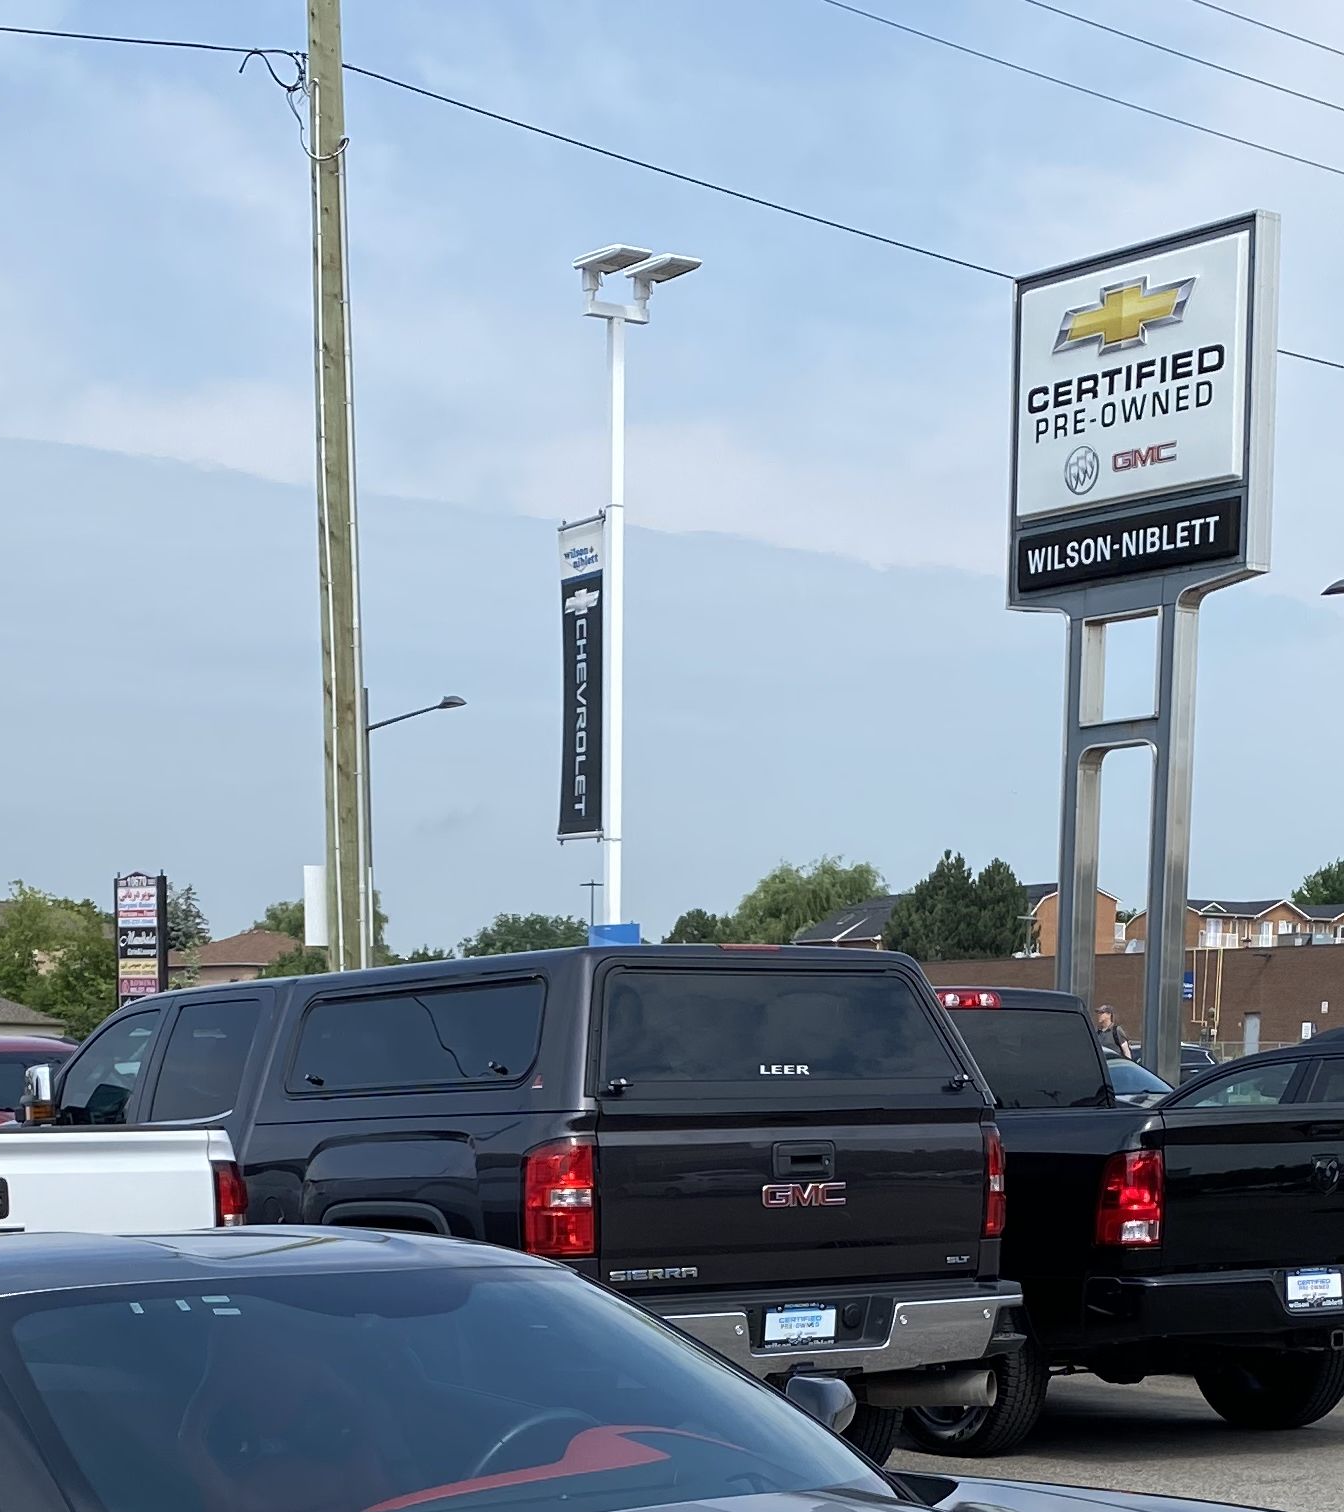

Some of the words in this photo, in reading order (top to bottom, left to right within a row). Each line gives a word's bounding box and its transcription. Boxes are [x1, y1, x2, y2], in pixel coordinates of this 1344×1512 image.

[1028, 344, 1224, 414] CERTIFIED
[1036, 380, 1213, 443] PRE-OWNED
[1111, 440, 1177, 473] GMC
[564, 548, 589, 560] wilson
[1028, 515, 1219, 574] WILSON-NIBLETT
[574, 618, 587, 817] CHEVROLET
[759, 1064, 810, 1076] LEER
[761, 1182, 847, 1209] GMC
[609, 1266, 698, 1283] SIERRA
[946, 1255, 970, 1264] SLT
